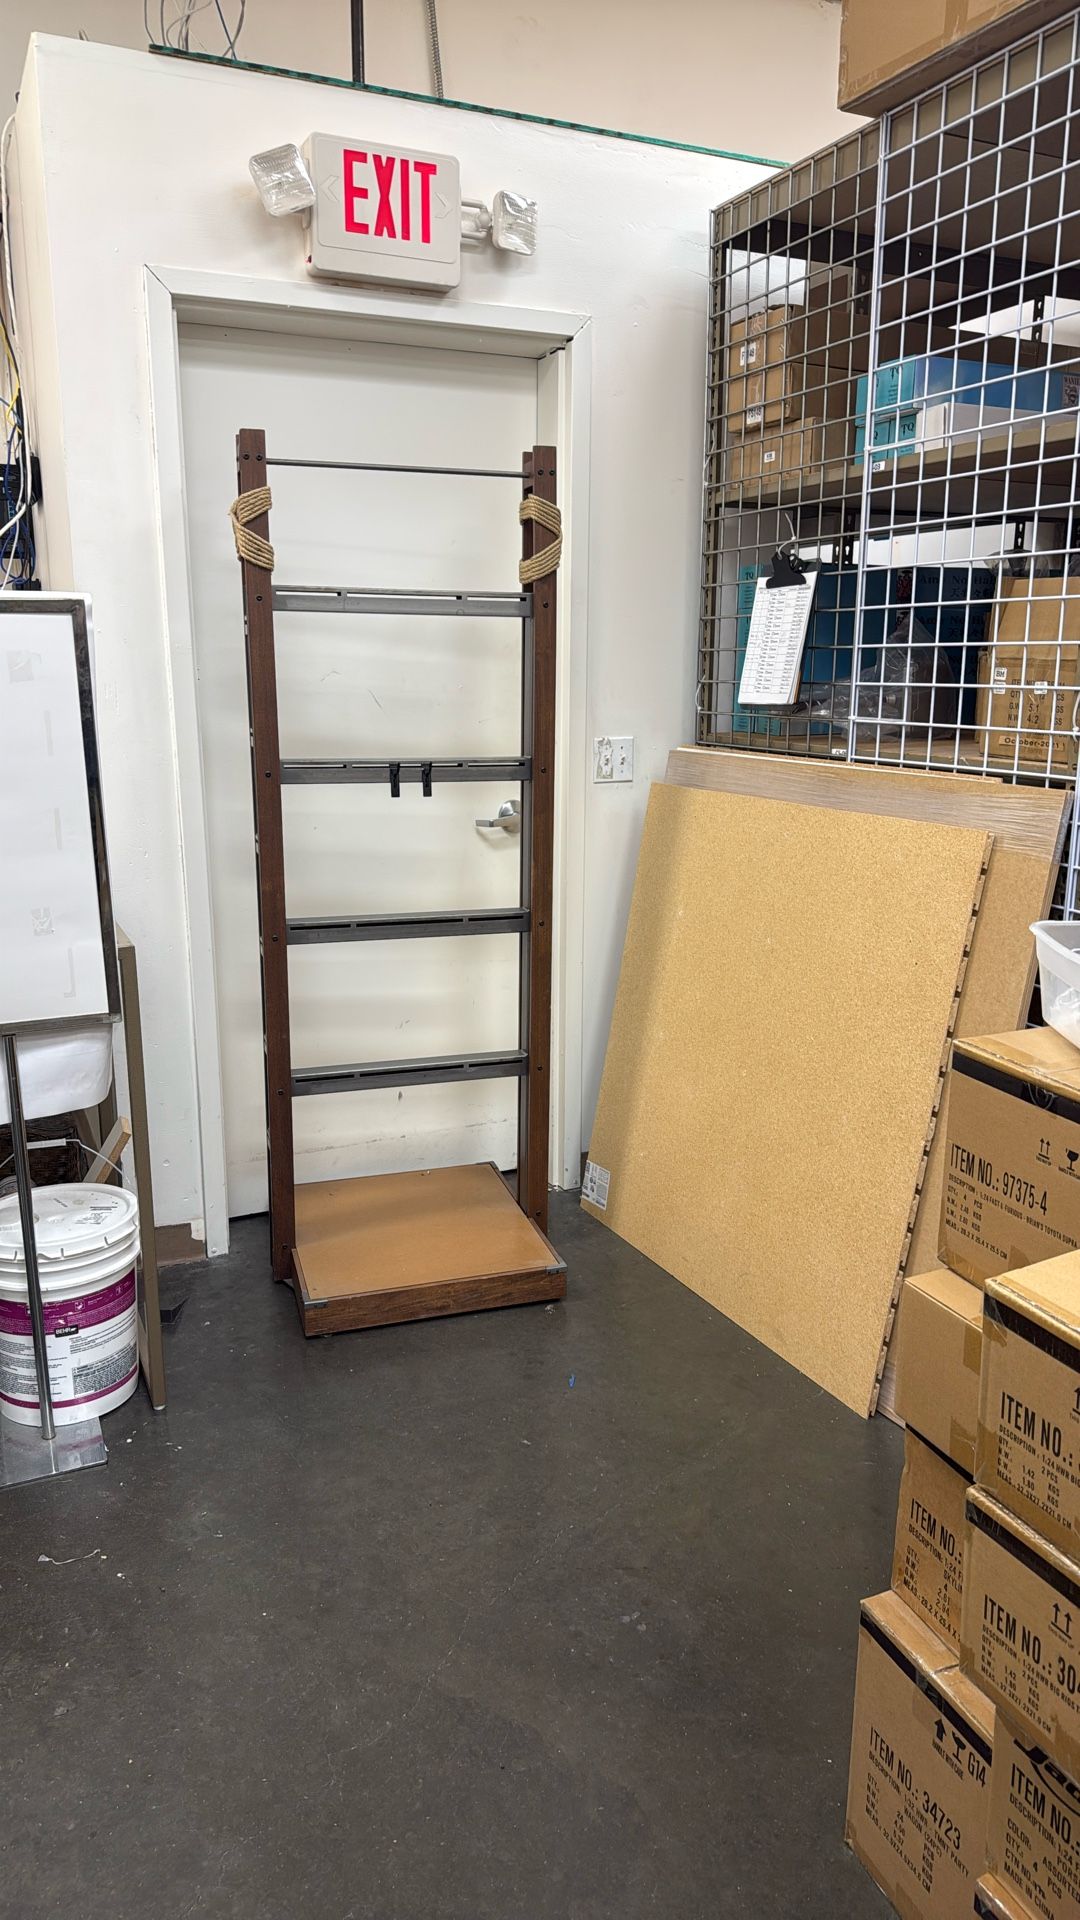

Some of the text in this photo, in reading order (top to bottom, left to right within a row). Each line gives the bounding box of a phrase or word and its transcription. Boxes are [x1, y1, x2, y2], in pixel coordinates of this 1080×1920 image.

[343, 148, 437, 244] EXIT
[902, 422, 914, 436] TQ
[996, 670, 1005, 678] BM
[950, 1143, 975, 1178] ITEM
[1003, 1172, 1047, 1216] 97375-4
[988, 1196, 1000, 1207] FAST
[1004, 1204, 1022, 1219] FURIOUS
[1044, 1225, 1061, 1240] TOYOTA
[55, 1327, 71, 1335] BEHR
[1001, 1391, 1035, 1440] ITEM
[1046, 1470, 1058, 1484] PCS
[1048, 1483, 1060, 1497] KGS
[1047, 1494, 1059, 1508] KGS
[910, 1498, 937, 1539] ITEM
[1062, 1518, 1072, 1529] CM
[984, 1594, 1017, 1644] ITEM
[1026, 1673, 1038, 1688] PCS
[1050, 1681, 1060, 1697] BIG
[1028, 1687, 1040, 1702] KGS
[1028, 1697, 1039, 1711] KGS
[968, 1751, 986, 1788] G14
[870, 1726, 894, 1771] ITEM
[922, 1791, 960, 1850] 34723
[1011, 1763, 1046, 1819] ITEM
[904, 1806, 922, 1833] WAGON
[951, 1851, 969, 1878] PARTY
[1005, 1847, 1020, 1869] CTN
[1004, 1861, 1023, 1890] MADE
[1025, 1884, 1033, 1900] IN
[1033, 1862, 1038, 1873] 4
[1047, 1876, 1062, 1899] PCS
